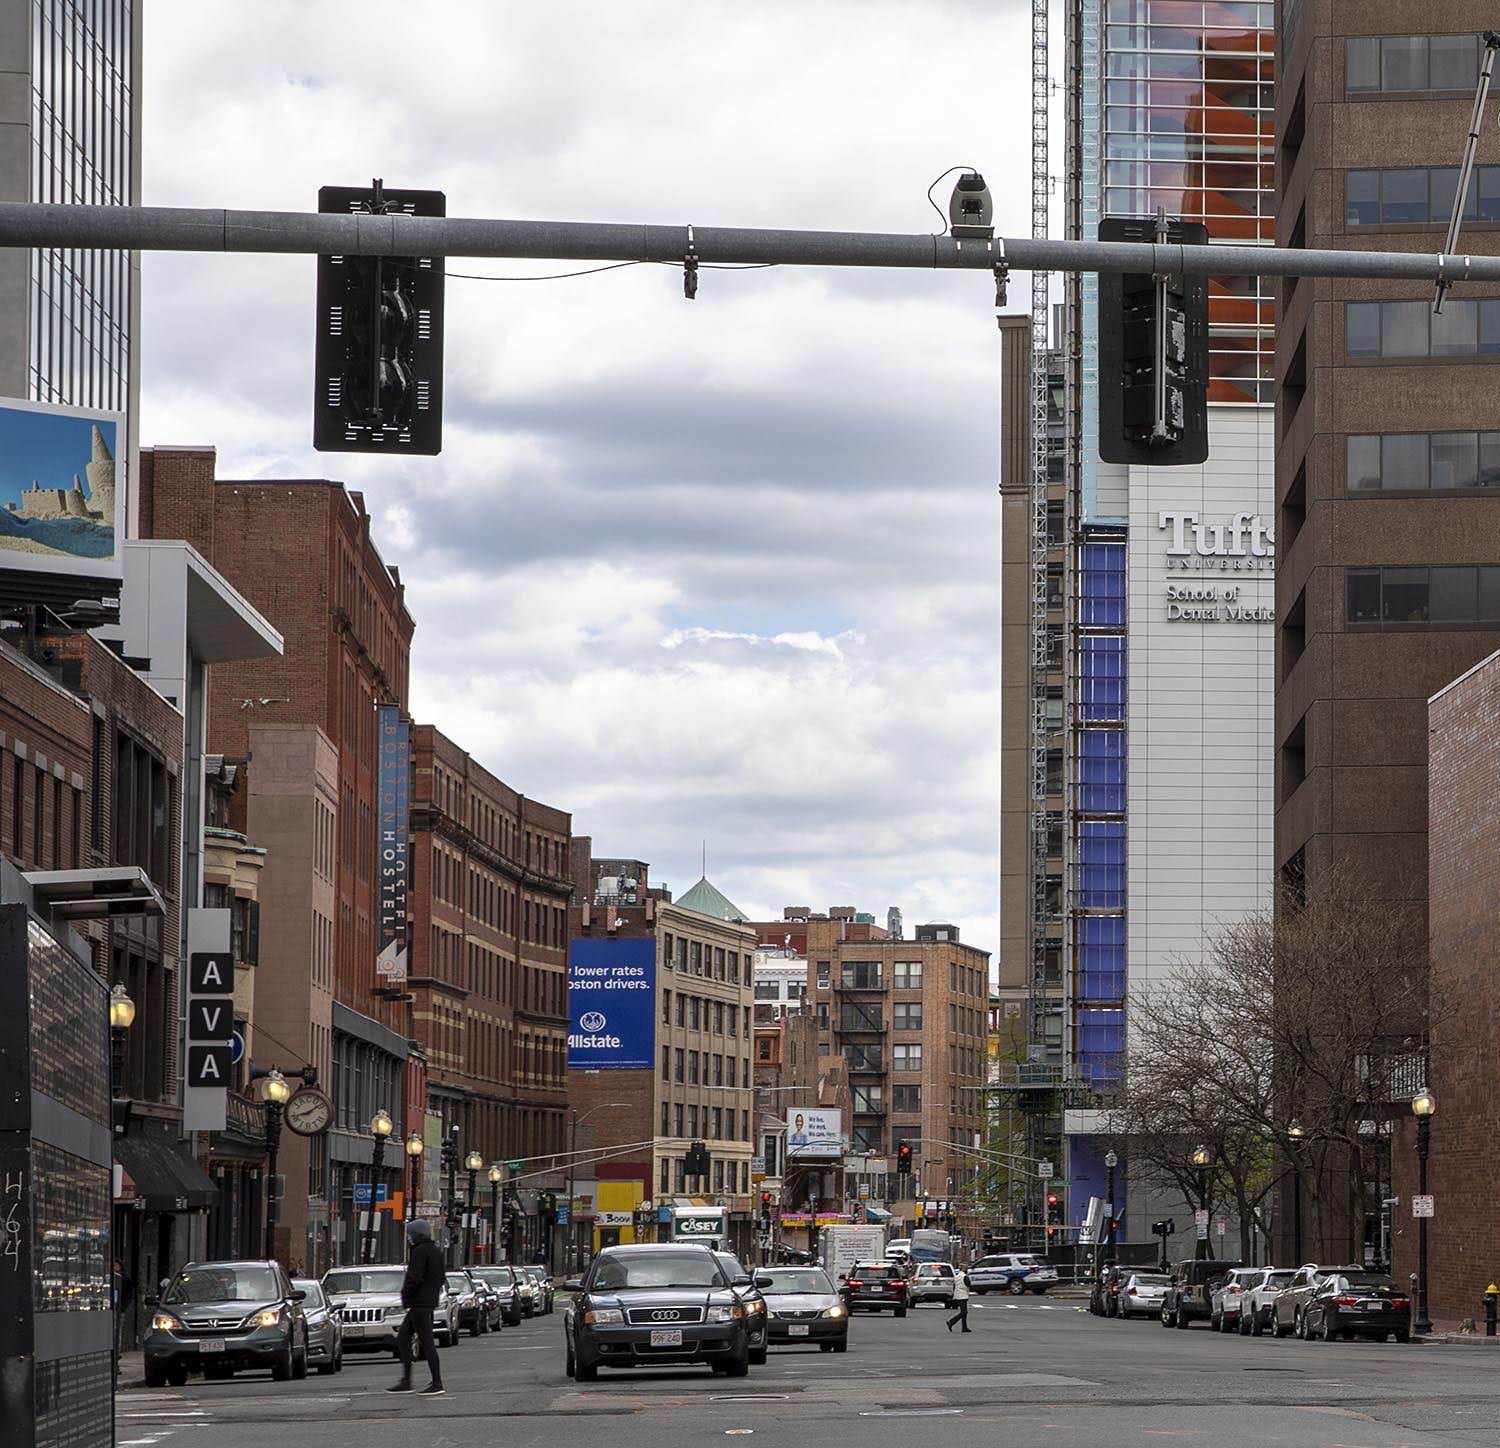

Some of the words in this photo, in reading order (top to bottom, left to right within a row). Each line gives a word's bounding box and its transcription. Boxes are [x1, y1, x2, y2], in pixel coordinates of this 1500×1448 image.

[1159, 511, 1275, 556] Tufts
[1167, 585, 1218, 601] School
[1223, 586, 1240, 601] of
[1167, 605, 1220, 620] Dental
[383, 726, 396, 824] BOSTON
[383, 831, 395, 925] HOSTEL
[575, 965, 609, 976] lower
[612, 966, 644, 976] rates
[604, 979, 650, 990] drivers.
[200, 961, 222, 1079] AVA
[680, 1218, 719, 1231] CASEY
